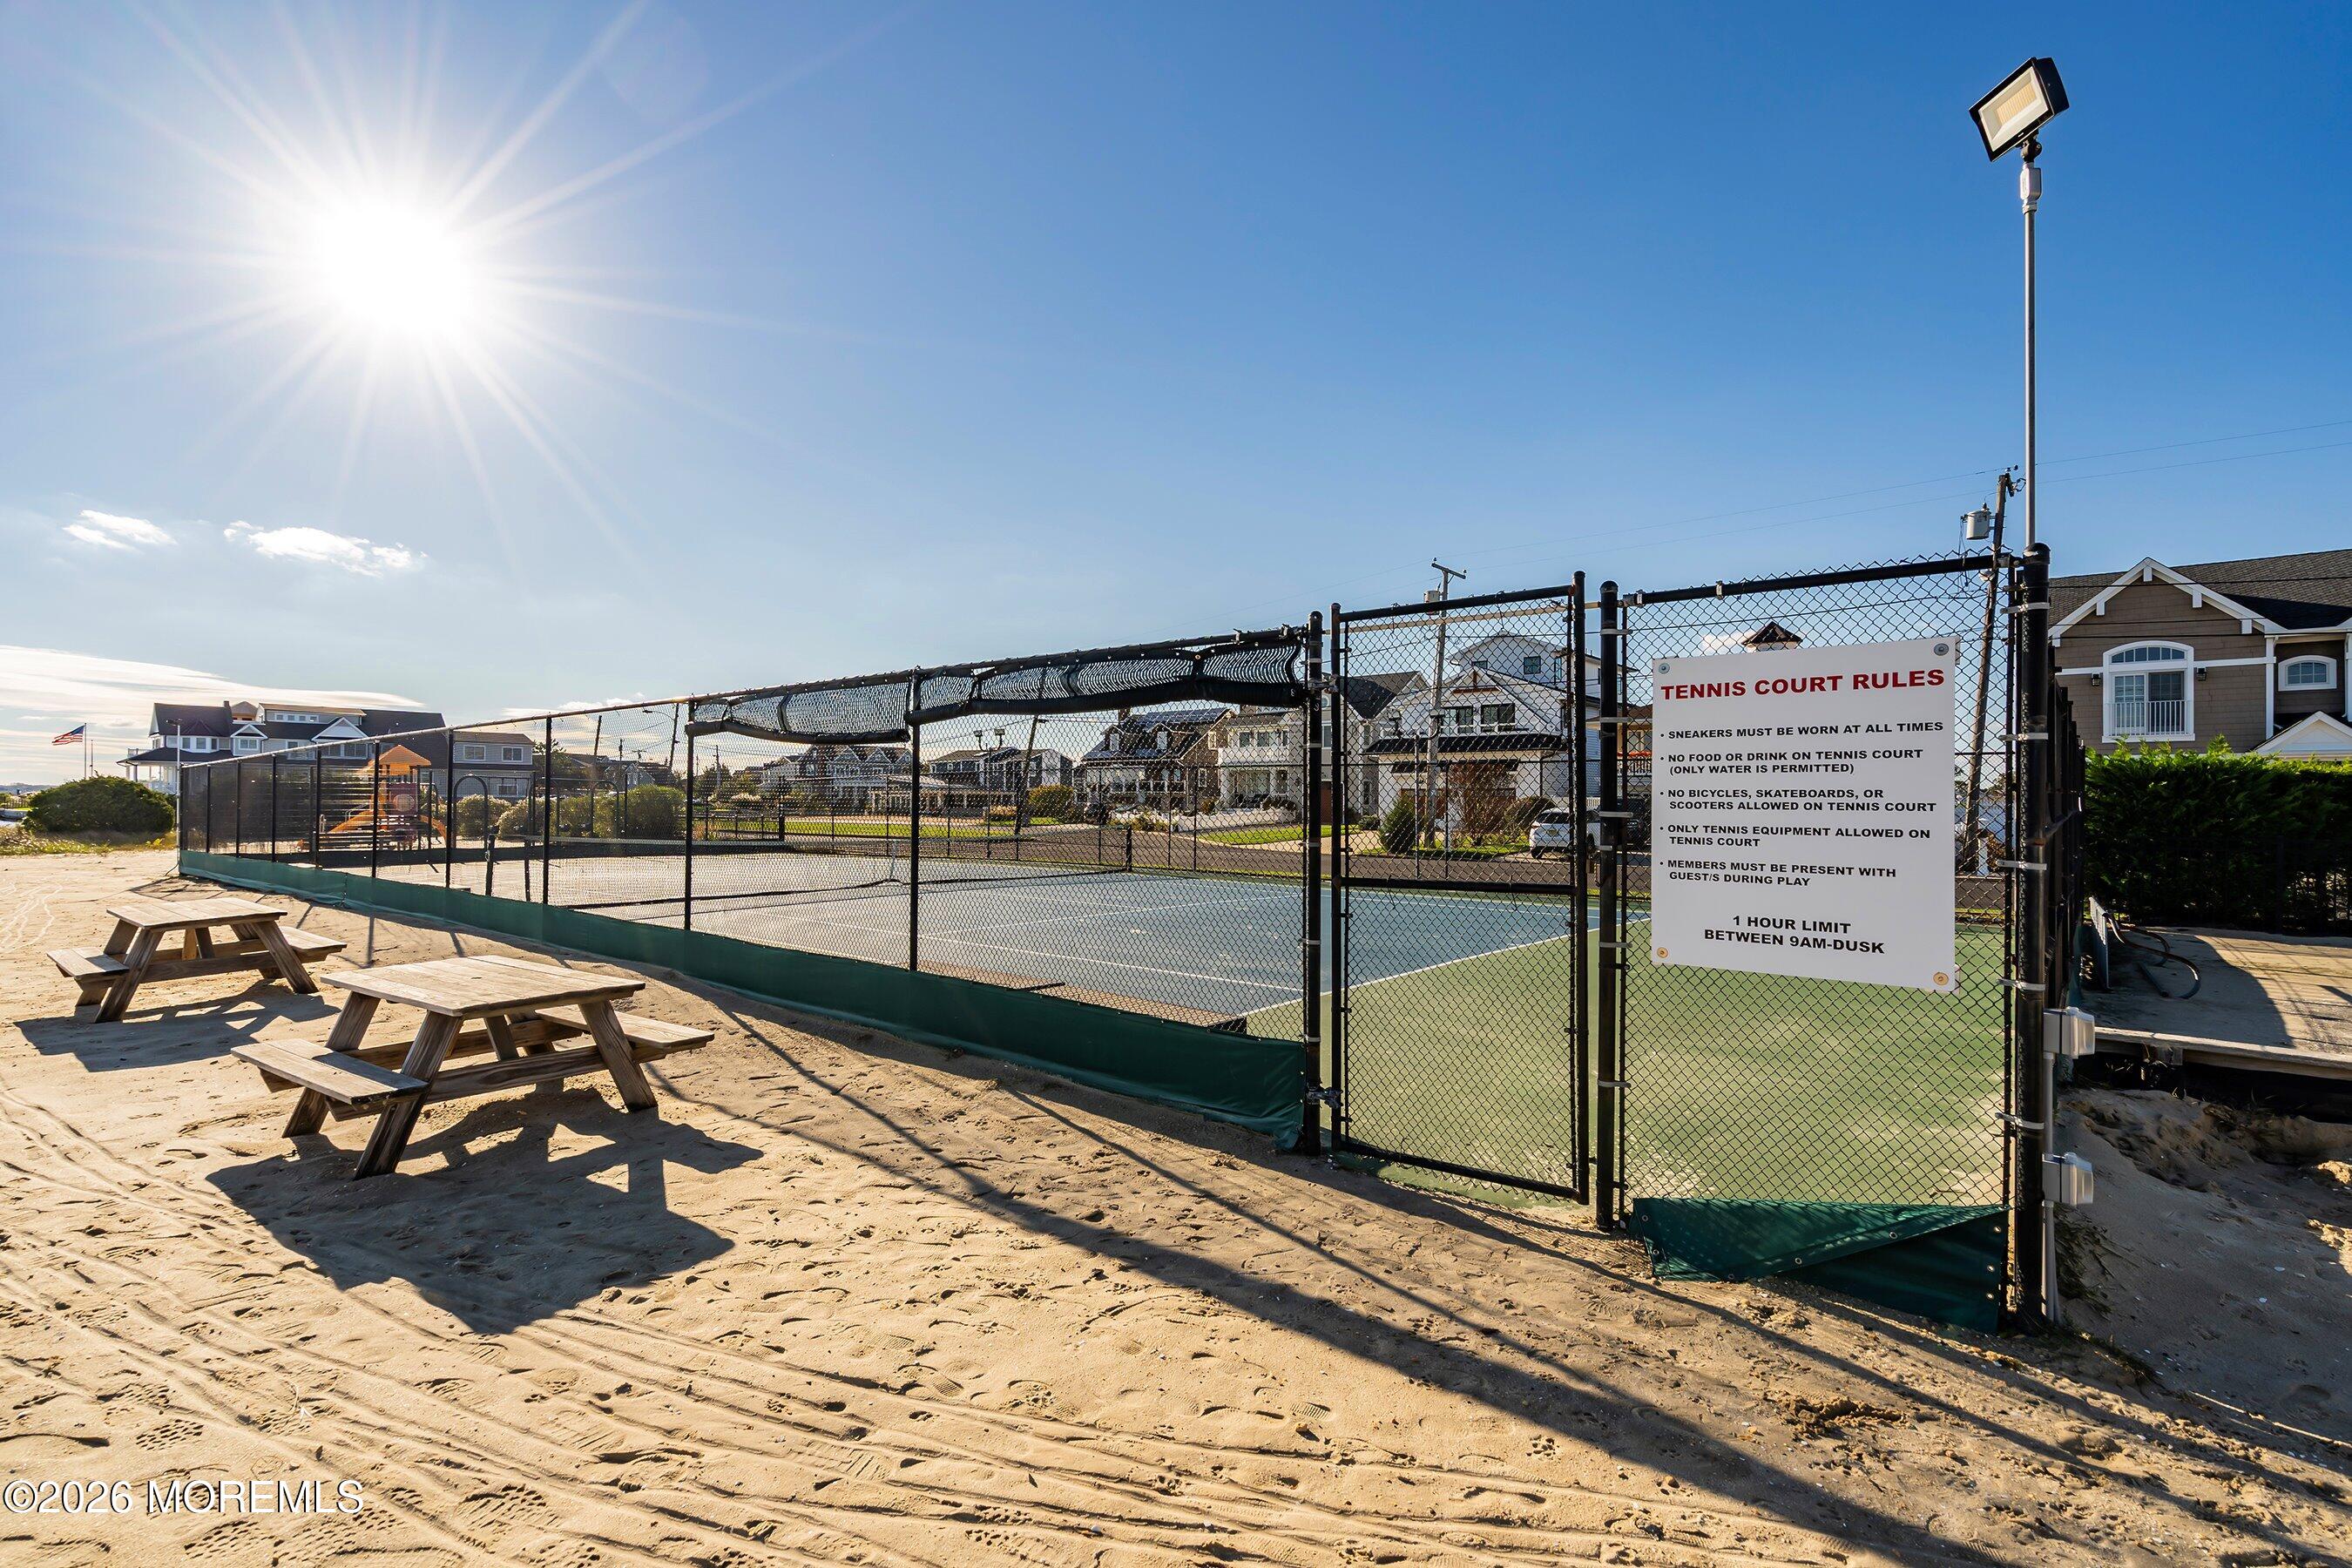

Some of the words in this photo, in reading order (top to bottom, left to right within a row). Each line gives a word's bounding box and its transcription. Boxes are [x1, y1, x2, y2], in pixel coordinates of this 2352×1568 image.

[1660, 680, 1747, 700] TENNIS
[1754, 675, 1843, 695] COURT
[1852, 669, 1945, 691] RULES
[1668, 728, 1733, 740] SNEAKERS
[1736, 727, 1773, 737] MUST
[1776, 727, 1794, 736] BE
[1797, 725, 1839, 735] WORN
[1842, 724, 1862, 734] AT
[1864, 723, 1893, 733] ALL
[1896, 721, 1943, 733] TIMES
[1668, 754, 1686, 762] NO
[1688, 753, 1722, 762] FOOD
[1725, 753, 1743, 761] OR
[1747, 752, 1788, 761] DRINK
[1791, 751, 1811, 760] ON
[1815, 750, 1868, 760] TENNIS
[1871, 748, 1924, 760] COURT
[1669, 765, 1706, 776] (ONLY
[1708, 765, 1752, 774] WATER
[1755, 764, 1768, 774] IS
[1772, 763, 1855, 774] PERMITTED)
[1667, 789, 1685, 798] NO
[1688, 789, 1752, 800] BICYCLES,
[1755, 788, 1859, 801] SKATEBOARDS,
[1863, 789, 1884, 799] OR
[1669, 801, 1734, 810] SCOOTERS
[1737, 801, 1800, 811] ALLOWED
[1803, 801, 1823, 811] ON
[1827, 801, 1880, 812] TENNIS
[1884, 802, 1937, 812] COURT
[1667, 824, 1700, 834] ONLY
[1702, 825, 1748, 835] TENNIS
[1752, 826, 1831, 836] EQUIPMENT
[1835, 828, 1904, 838] ALLOWED
[1908, 828, 1930, 839] ON
[1668, 836, 1713, 846] TENNIS
[1717, 837, 1761, 847] COURT
[1667, 859, 1727, 870] MEMBERS
[1730, 862, 1767, 872] MUST
[1770, 863, 1788, 873] BE
[1791, 864, 1855, 875] PRESENT
[1858, 867, 1896, 878] WITH
[1669, 871, 1720, 882] GUEST/S
[1723, 874, 1774, 885] DURING
[1777, 876, 1811, 887] PLAY
[1733, 915, 1740, 926] 1
[1747, 916, 1796, 930] HOUR
[1801, 920, 1852, 935] LIMIT
[1704, 929, 1784, 946] BETWEEN
[1789, 936, 1885, 955] 9AM-DUSK
